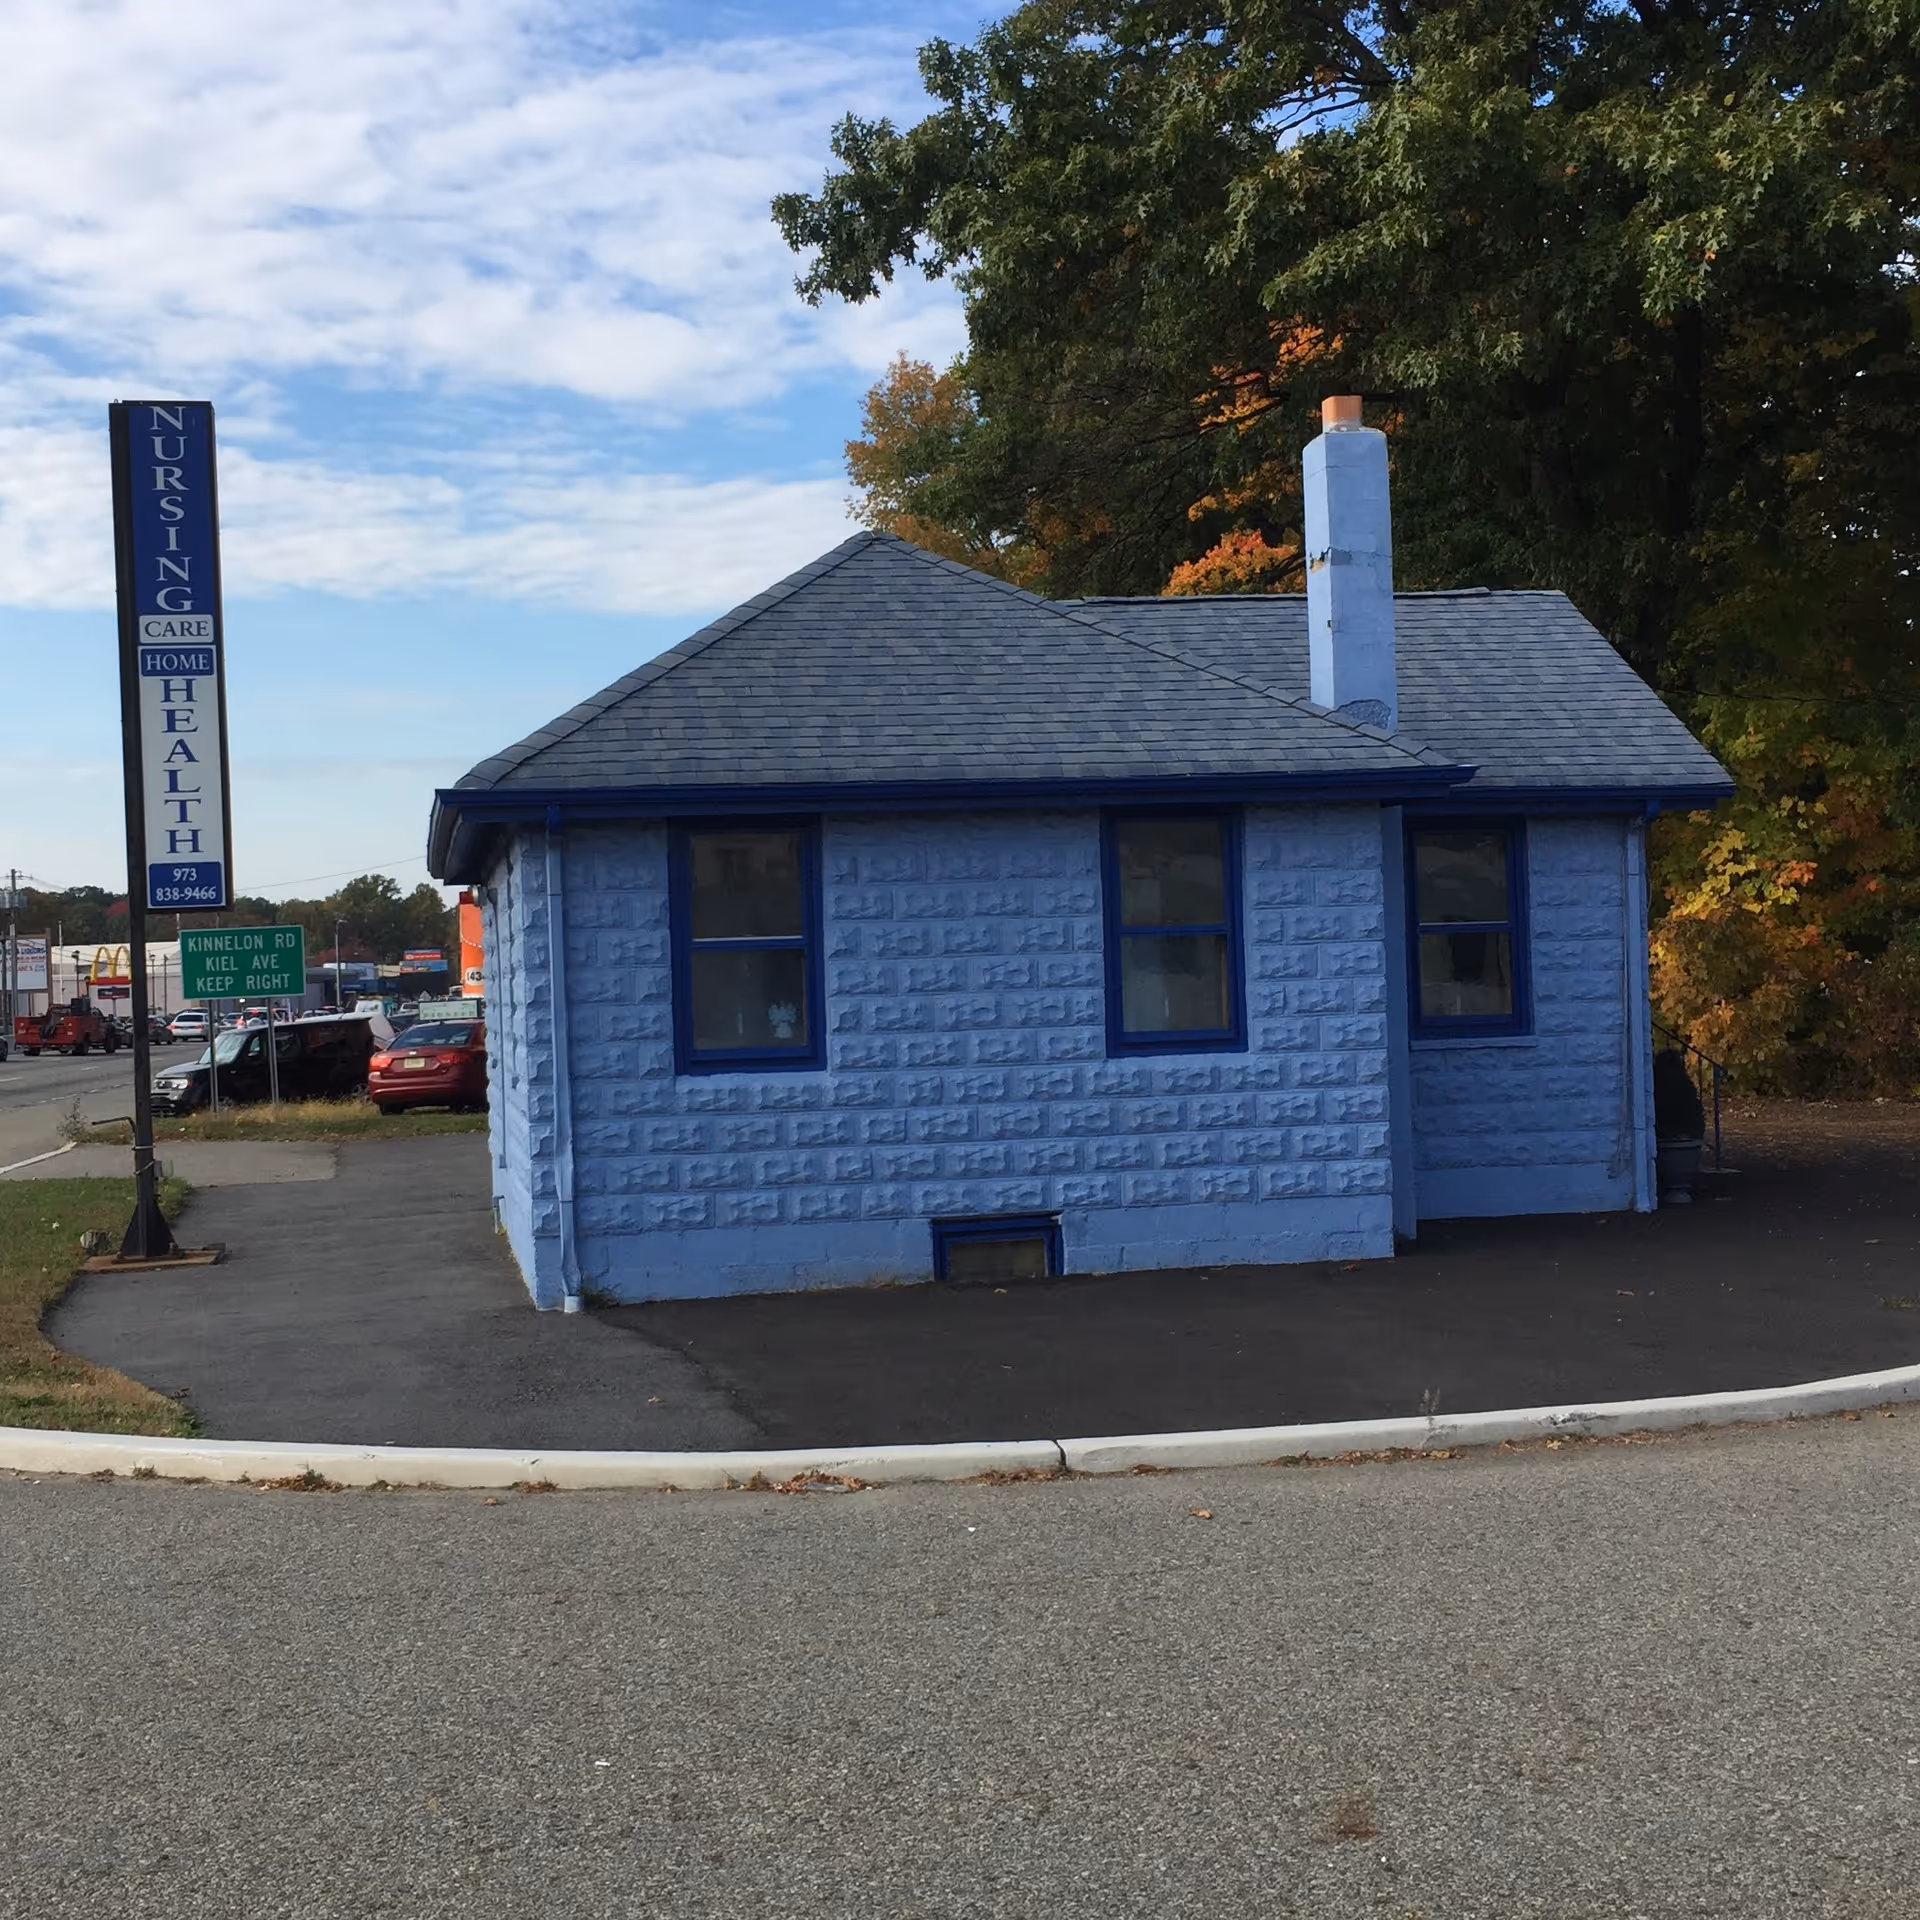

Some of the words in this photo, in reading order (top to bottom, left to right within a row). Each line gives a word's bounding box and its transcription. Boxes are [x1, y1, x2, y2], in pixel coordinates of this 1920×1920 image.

[149, 406, 194, 612] NURSING
[144, 620, 210, 638] CARE
[146, 653, 210, 672] HOME
[160, 678, 204, 854] HEALTH
[172, 868, 197, 882] 973
[156, 886, 217, 902] 838-9466
[188, 934, 263, 952] KINNELON
[275, 933, 296, 948] RD
[205, 956, 239, 971] KIEL
[252, 954, 280, 969] AVE
[196, 976, 234, 992] KEEP
[246, 973, 290, 990] RIGHT
